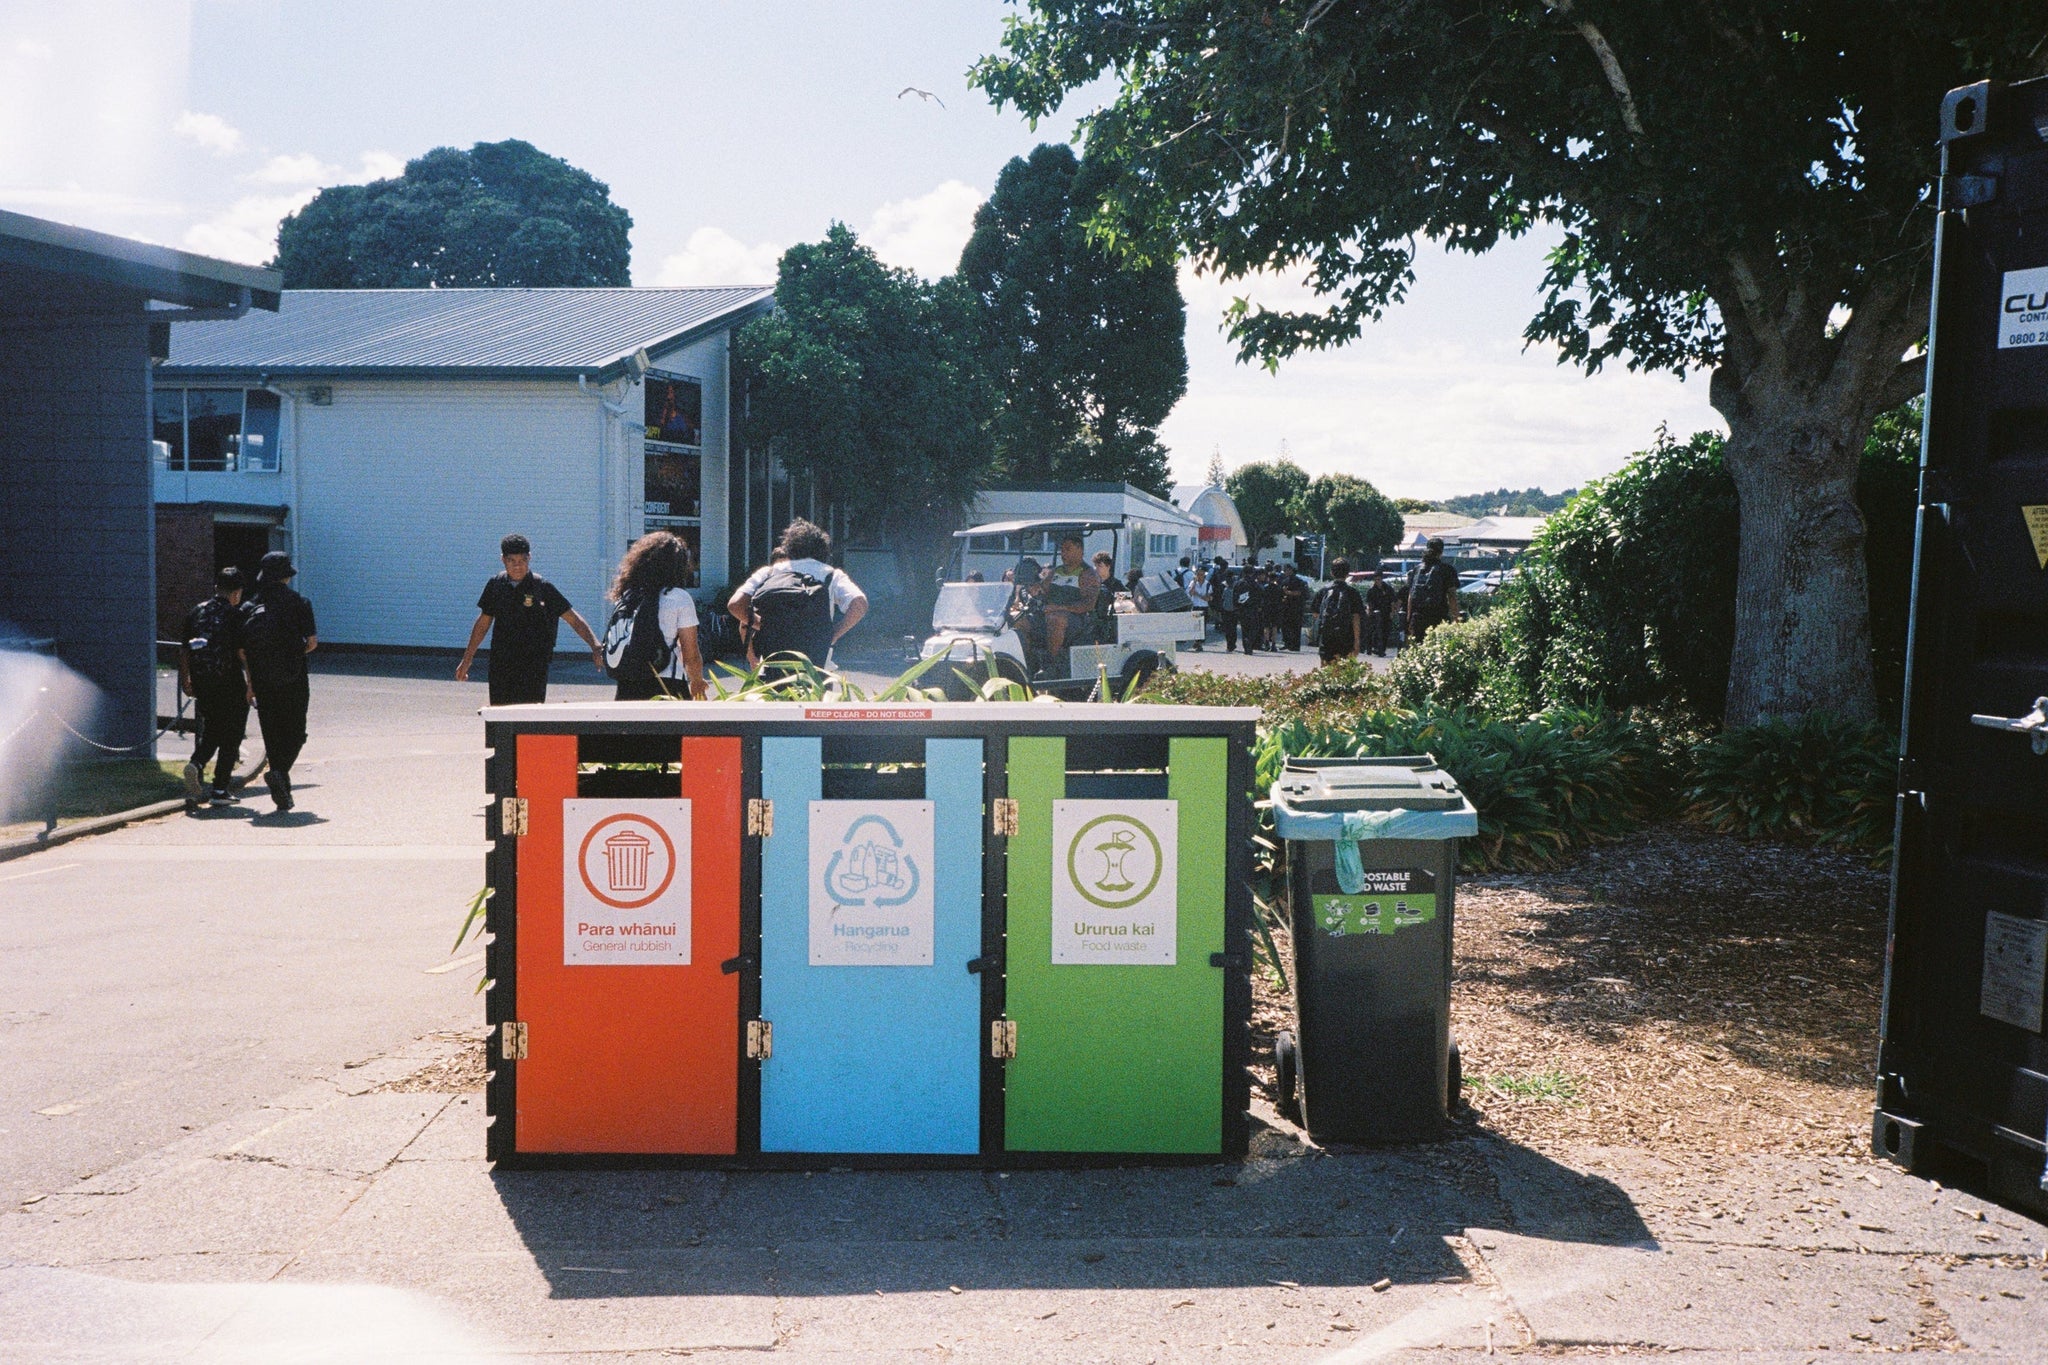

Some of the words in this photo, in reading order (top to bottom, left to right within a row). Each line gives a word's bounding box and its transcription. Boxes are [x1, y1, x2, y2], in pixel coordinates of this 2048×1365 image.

[2019, 312, 2048, 323] CONT
[2009, 332, 2036, 345] 0800
[810, 710, 832, 718] KEEP
[833, 710, 860, 718] CLEAR
[866, 710, 879, 718] DO
[880, 710, 897, 718] NOT
[898, 710, 926, 718] BLOCK
[1373, 882, 1407, 892] WASTE
[578, 922, 615, 936] Para
[619, 922, 677, 936] whānui
[834, 923, 910, 939] Hangarua
[1073, 922, 1127, 936] Ururua
[1132, 922, 1155, 936] kai
[582, 940, 627, 952] General
[629, 940, 672, 952] rubbish
[845, 941, 899, 953] Recycling
[1081, 939, 1111, 951] Food
[1113, 940, 1147, 951] waste
